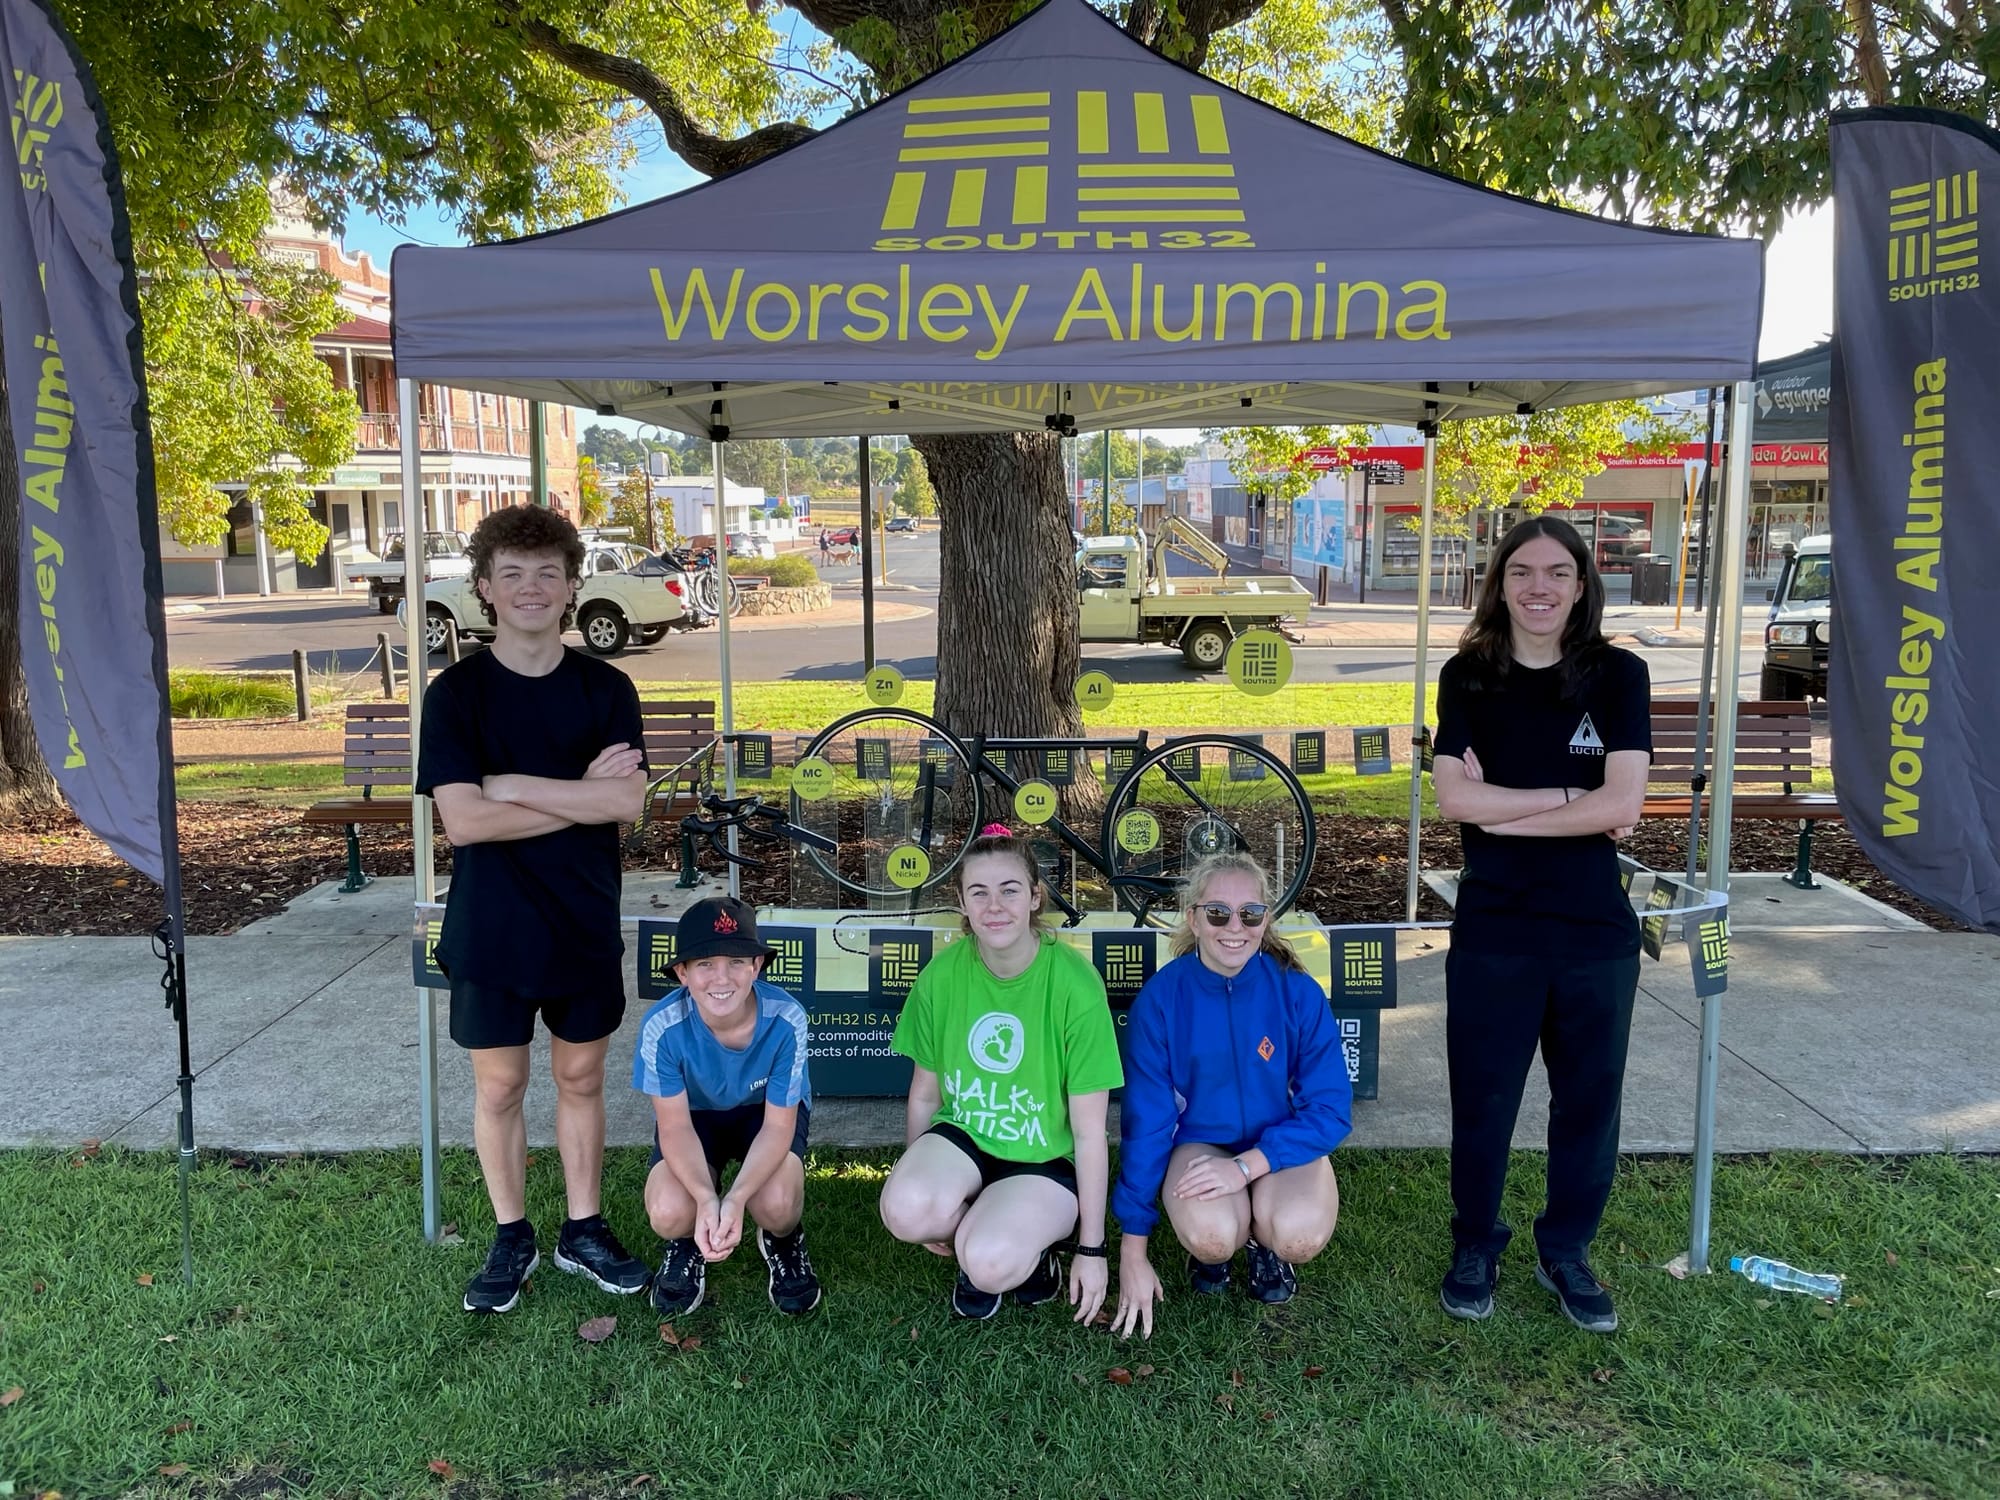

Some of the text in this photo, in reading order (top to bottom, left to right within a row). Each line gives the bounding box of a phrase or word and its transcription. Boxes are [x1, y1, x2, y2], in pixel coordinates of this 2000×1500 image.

[871, 230, 1256, 252] SOUTH32
[1889, 273, 1980, 303] SOUTH32
[649, 262, 1452, 361] Worsley Alumina
[1771, 375, 1811, 391] outdoor
[1751, 448, 1776, 462] lden
[1781, 445, 1814, 463] Bowl
[1639, 457, 1665, 465] Districts
[1882, 357, 1947, 838] Worsley Alumina
[876, 679, 893, 690] Zn
[1088, 683, 1102, 694] Al
[1569, 746, 1605, 756] LUCID
[803, 768, 822, 778] MC
[1025, 794, 1045, 806] Cu
[901, 858, 916, 870] Ni
[767, 975, 803, 983] SOUTH32
[1106, 981, 1144, 989] SOUTH32
[1345, 979, 1383, 987] SOUTH32
[805, 1013, 860, 1025] UTH32
[864, 1013, 877, 1025] IS
[880, 1013, 892, 1025] A
[818, 1030, 894, 1041] commoditie
[845, 1045, 859, 1057] of
[1027, 1095, 1046, 1113] for
